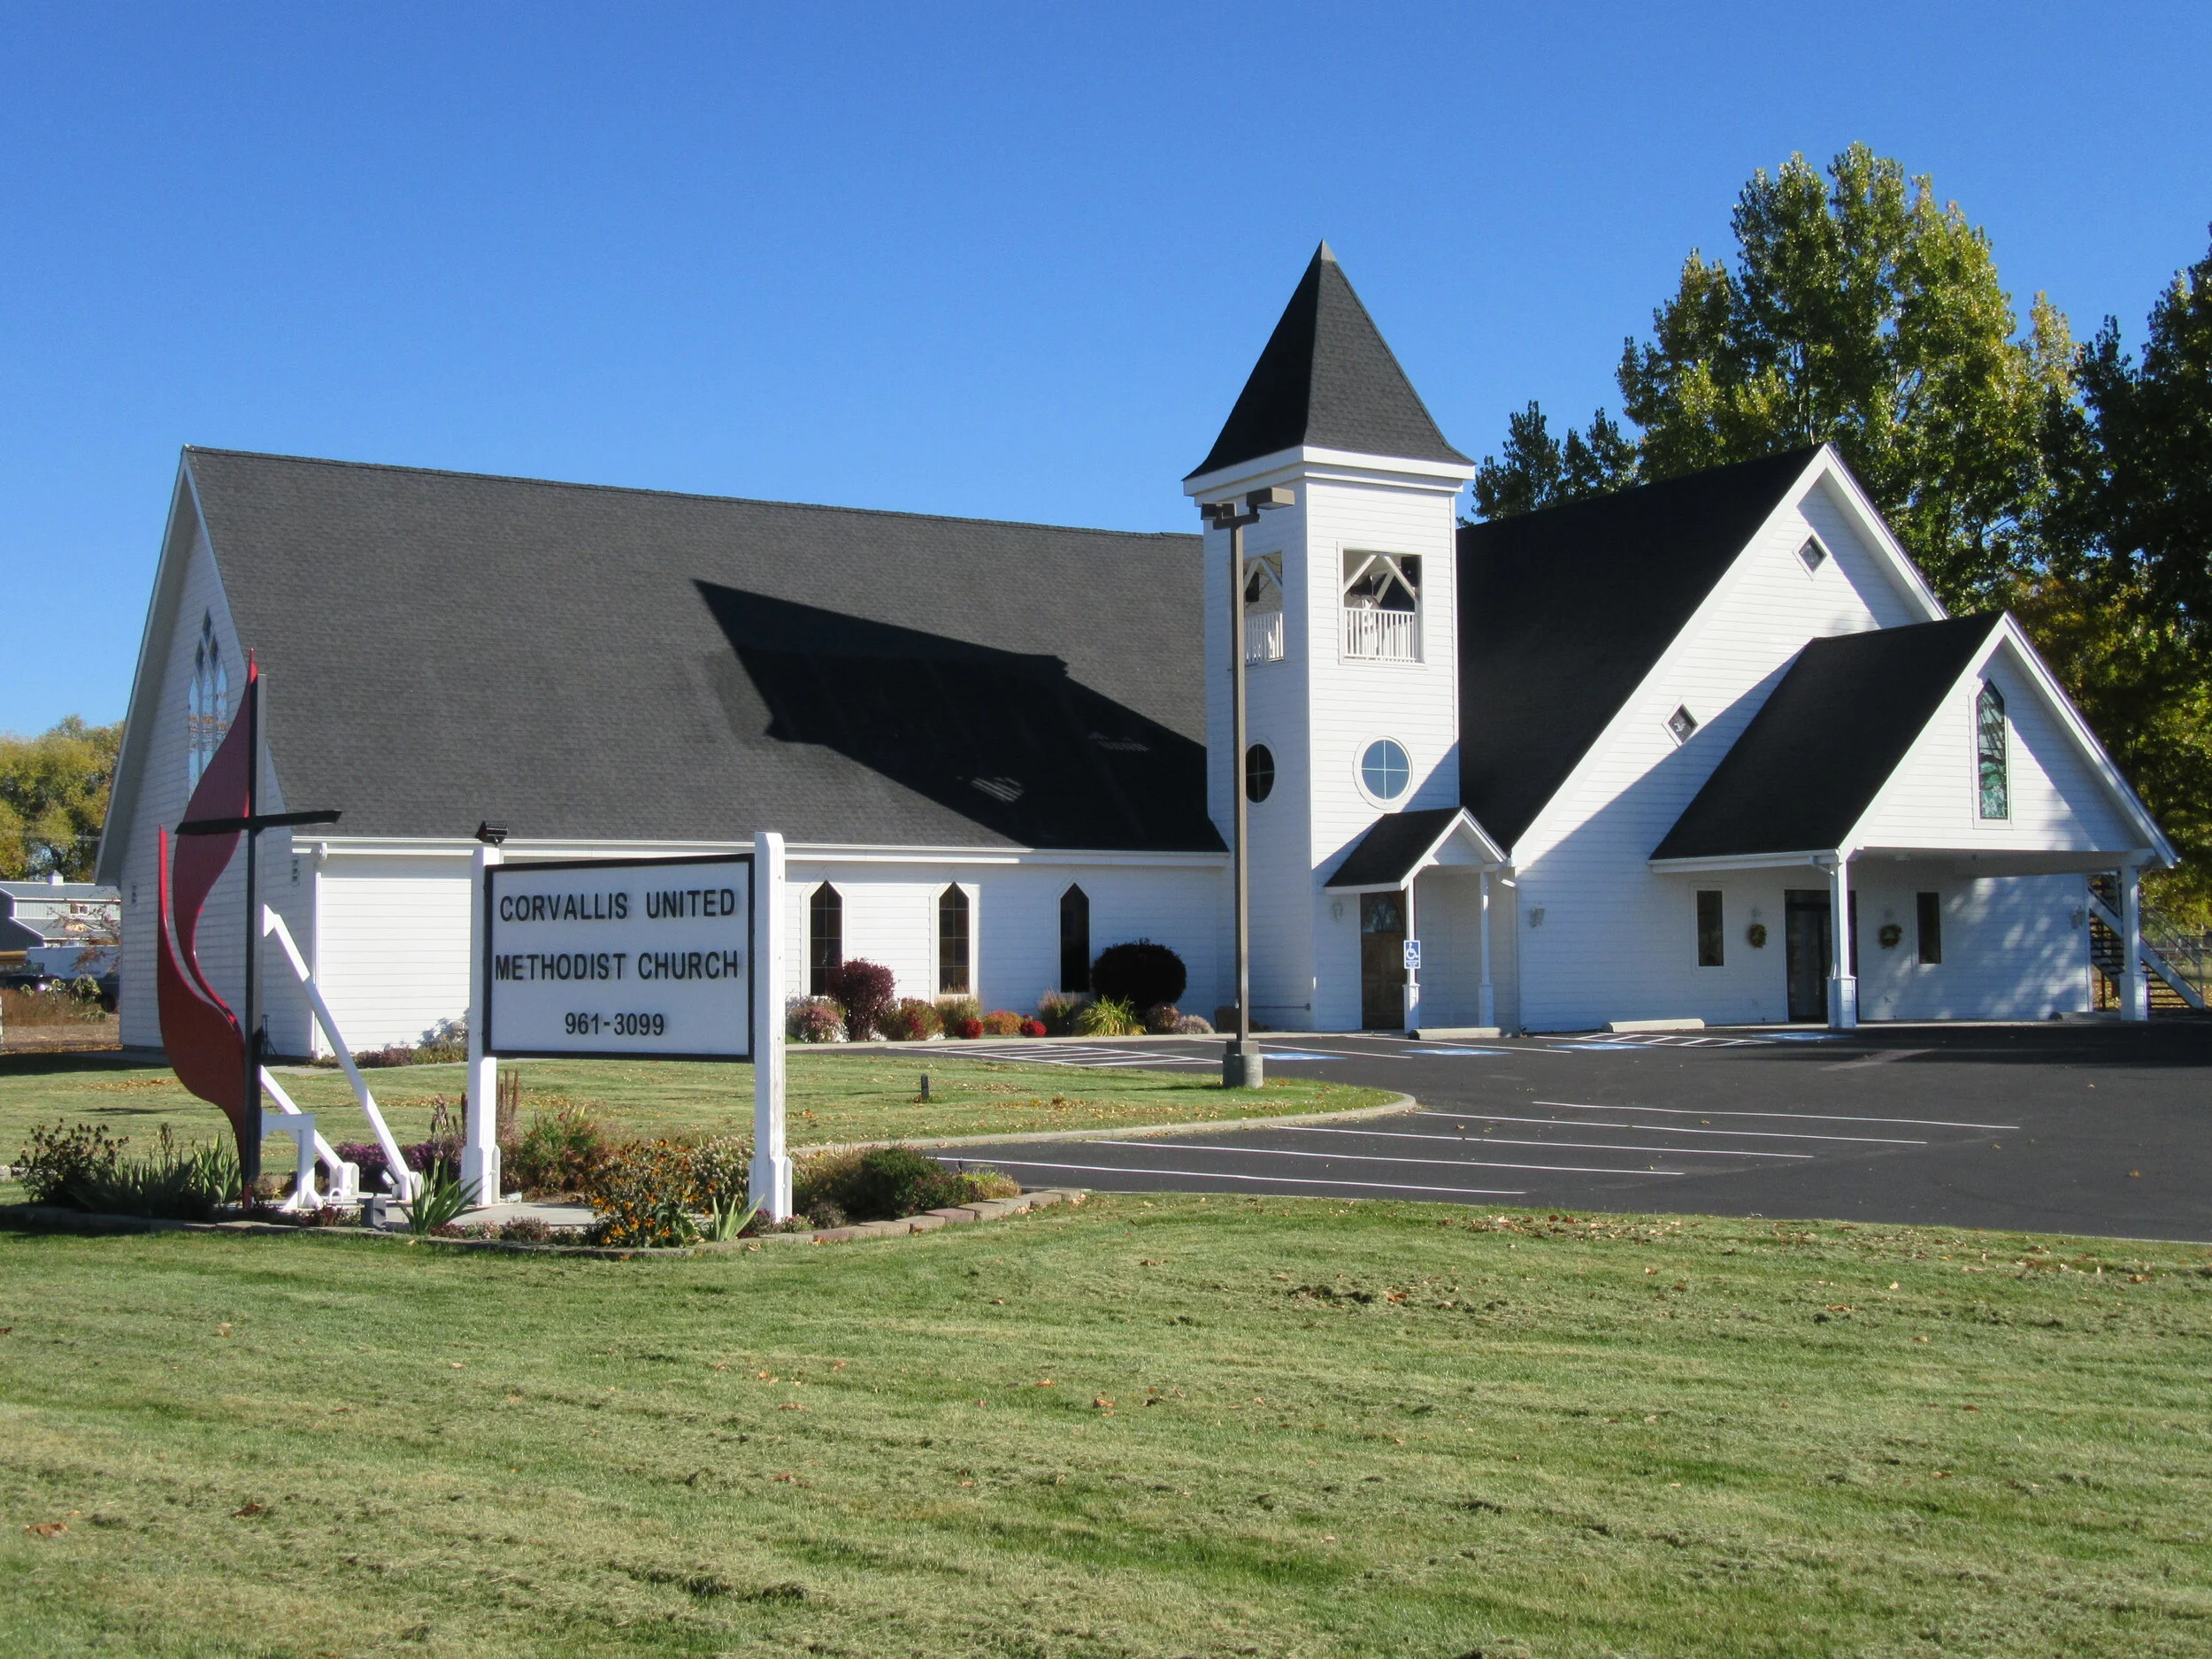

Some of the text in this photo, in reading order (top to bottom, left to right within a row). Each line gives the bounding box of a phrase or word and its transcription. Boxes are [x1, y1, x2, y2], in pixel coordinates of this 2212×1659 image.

[500, 888, 736, 922] CORVALLIS UNITED
[495, 949, 738, 981] METHODIST CHURCH
[565, 1011, 664, 1036] 961-3099
